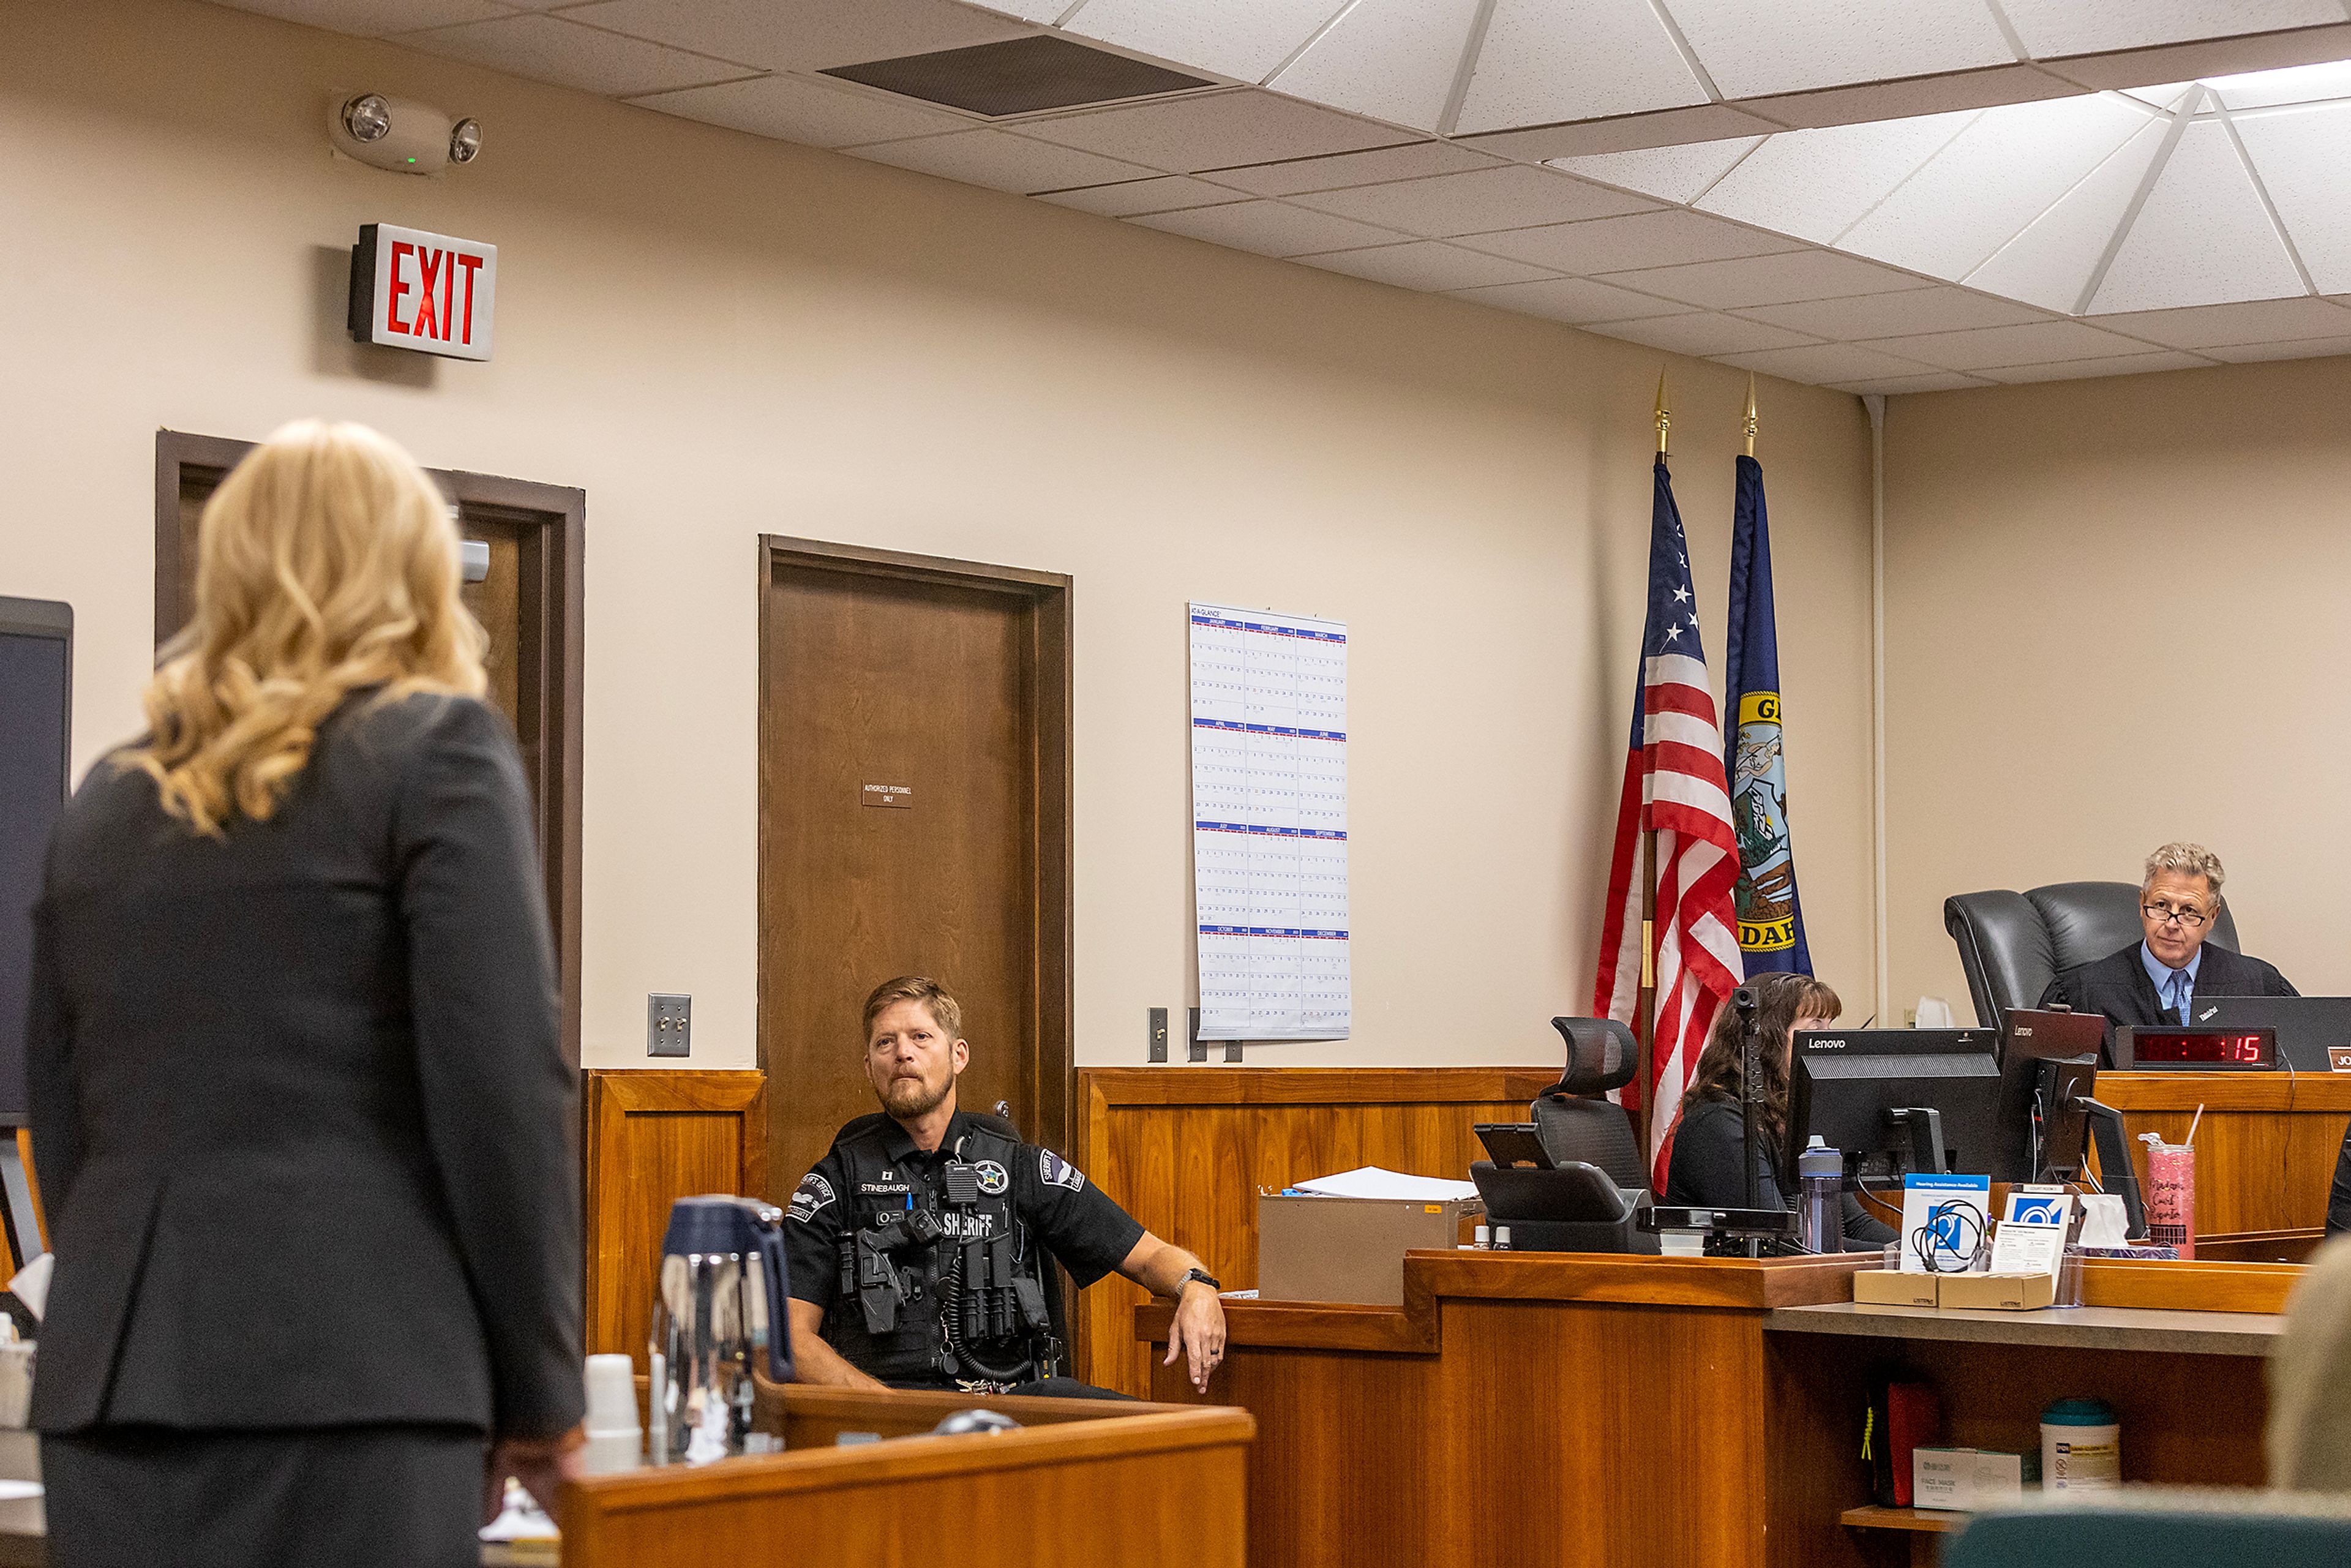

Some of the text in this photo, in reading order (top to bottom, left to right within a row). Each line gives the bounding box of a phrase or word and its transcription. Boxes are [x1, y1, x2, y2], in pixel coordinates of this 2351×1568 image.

[388, 241, 483, 345] EXIT
[2015, 1025, 2033, 1037] Lenovo
[1809, 1038, 1846, 1049] Lenovo
[2235, 1036, 2260, 1061] 15
[861, 1183, 910, 1193] STINEBAUGH
